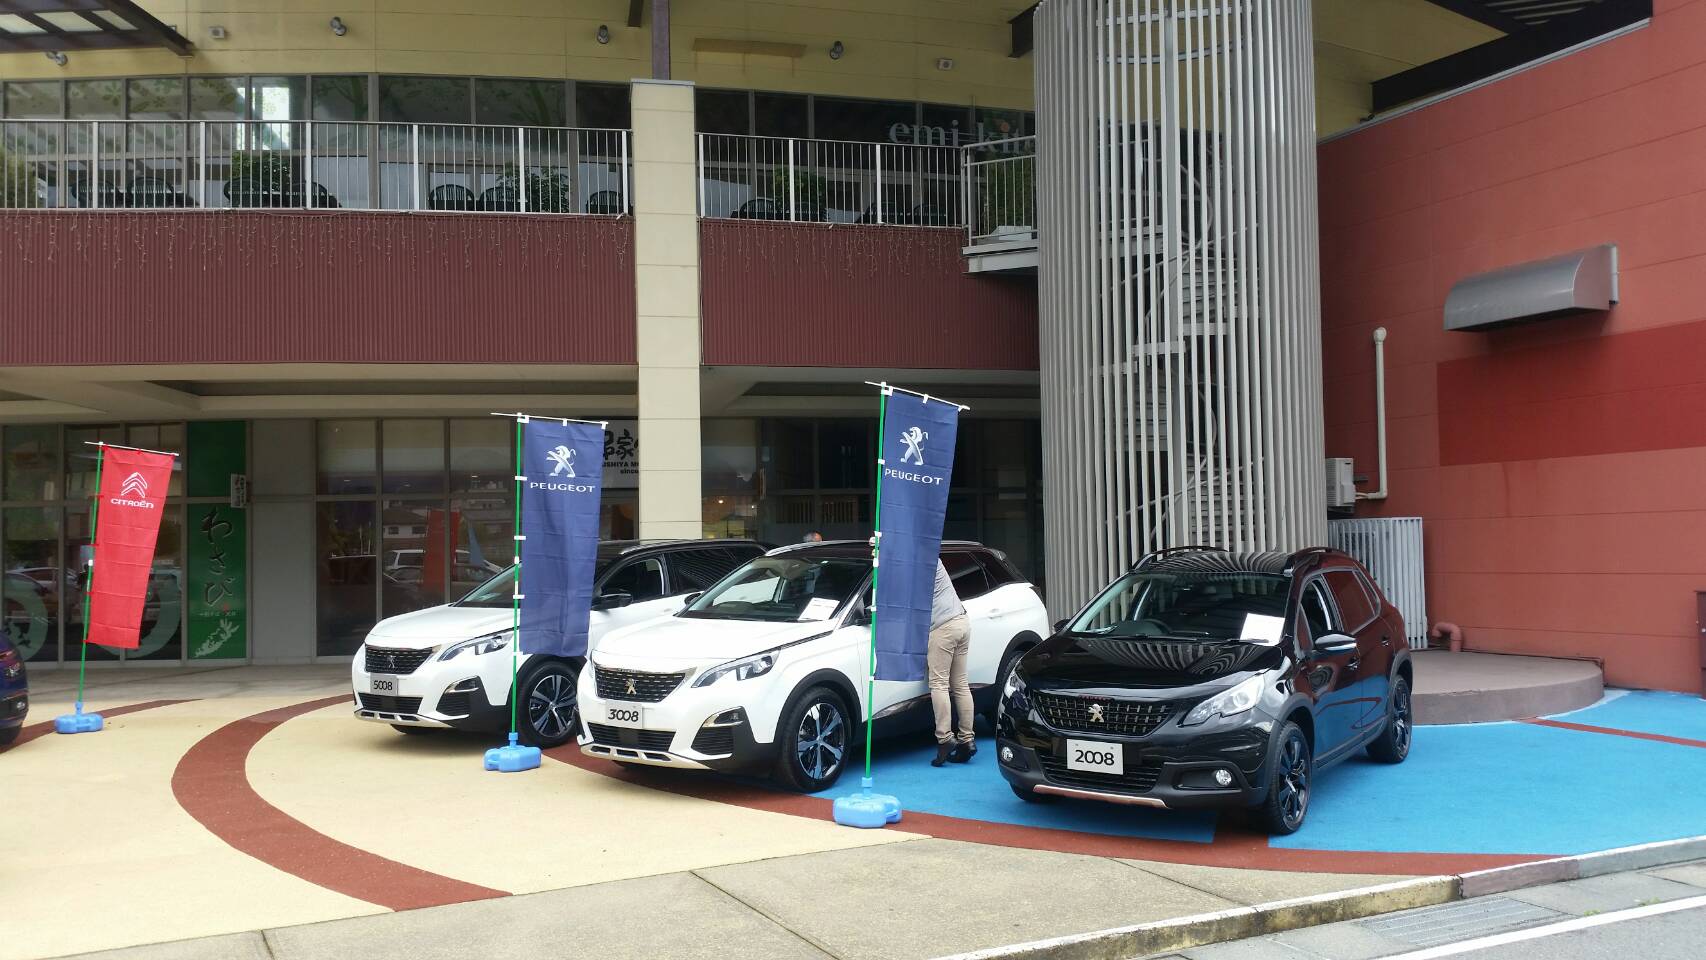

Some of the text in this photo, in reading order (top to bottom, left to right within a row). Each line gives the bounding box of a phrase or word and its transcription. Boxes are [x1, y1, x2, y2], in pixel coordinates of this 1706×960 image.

[884, 468, 944, 485] PEUGEOT
[530, 482, 596, 493] PEUGEOT
[201, 506, 236, 607] わさび
[373, 680, 393, 691] 5008
[608, 708, 639, 722] 3008
[1075, 749, 1115, 766] 2008
